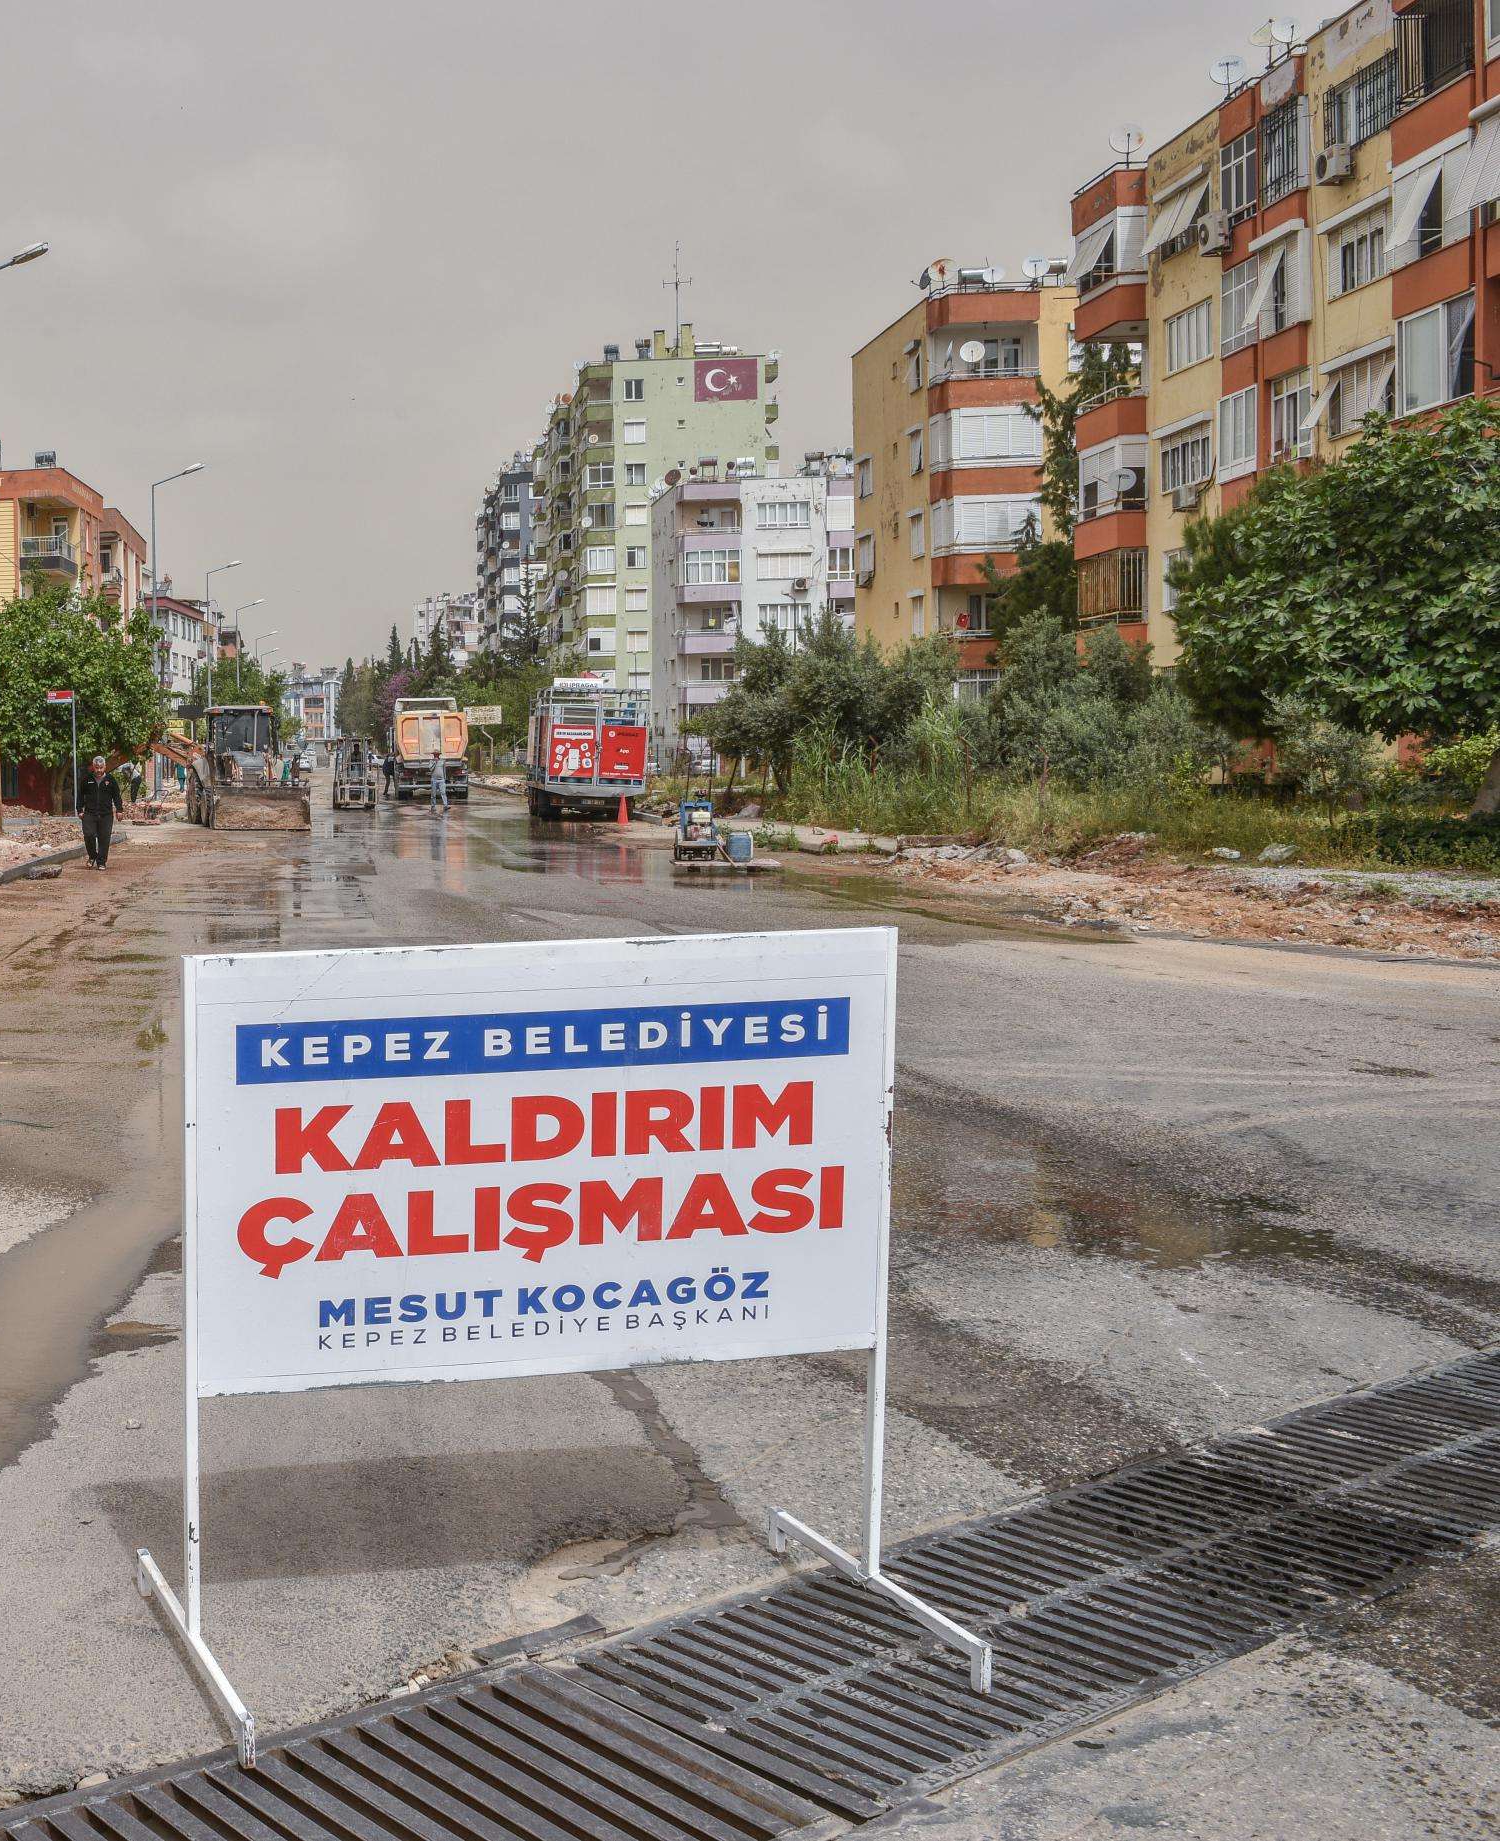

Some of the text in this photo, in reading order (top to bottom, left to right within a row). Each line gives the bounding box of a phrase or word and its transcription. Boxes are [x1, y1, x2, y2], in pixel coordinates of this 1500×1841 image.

[261, 1004, 829, 1067] KEPEZ BELEDİYESİ
[275, 1080, 814, 1175] KALDIRIM
[236, 1165, 845, 1280] ÇALIŞMASI
[318, 1267, 770, 1329] MESUT KOCAGÖZ
[318, 1303, 770, 1351] KEPEZ BELEDİYE BAŞKANI
